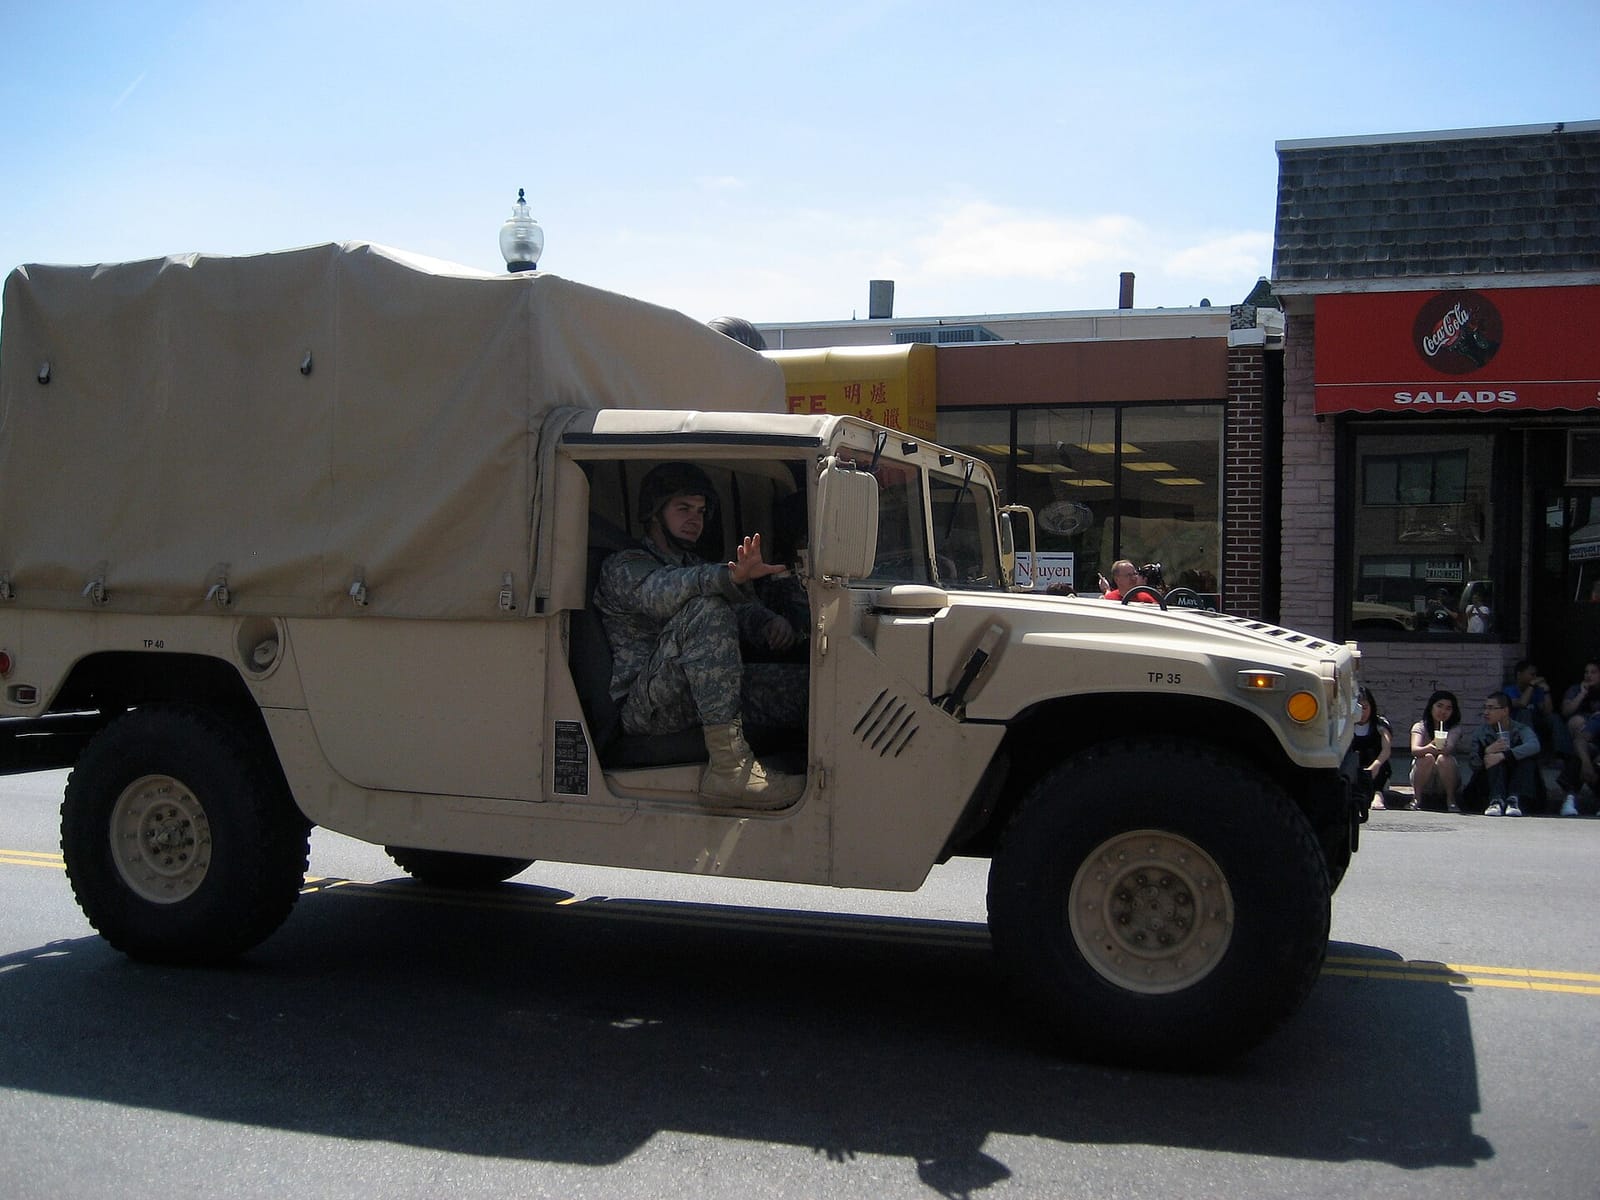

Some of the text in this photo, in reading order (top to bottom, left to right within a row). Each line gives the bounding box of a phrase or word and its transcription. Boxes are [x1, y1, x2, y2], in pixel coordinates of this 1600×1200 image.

[1423, 301, 1469, 356] Coca-Cola
[1394, 391, 1517, 404] SALADS
[143, 639, 164, 649] TP 40
[1147, 672, 1181, 684] TP 35
